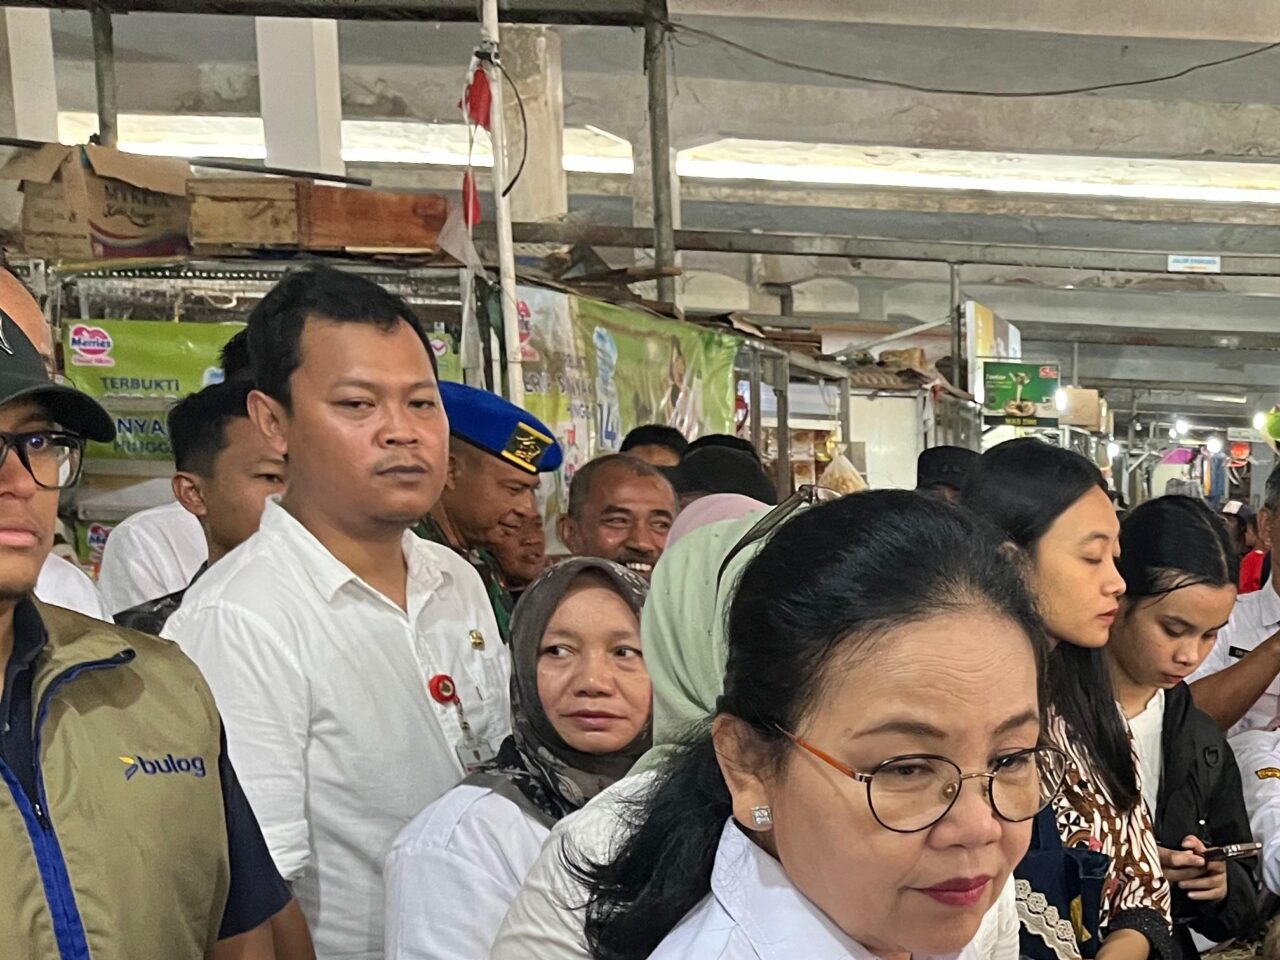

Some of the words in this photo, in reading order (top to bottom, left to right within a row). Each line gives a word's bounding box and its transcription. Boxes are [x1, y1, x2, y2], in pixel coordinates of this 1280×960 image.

[71, 337, 111, 348] Merries
[100, 376, 181, 392] TERBUKTI
[136, 753, 207, 778] bulog
